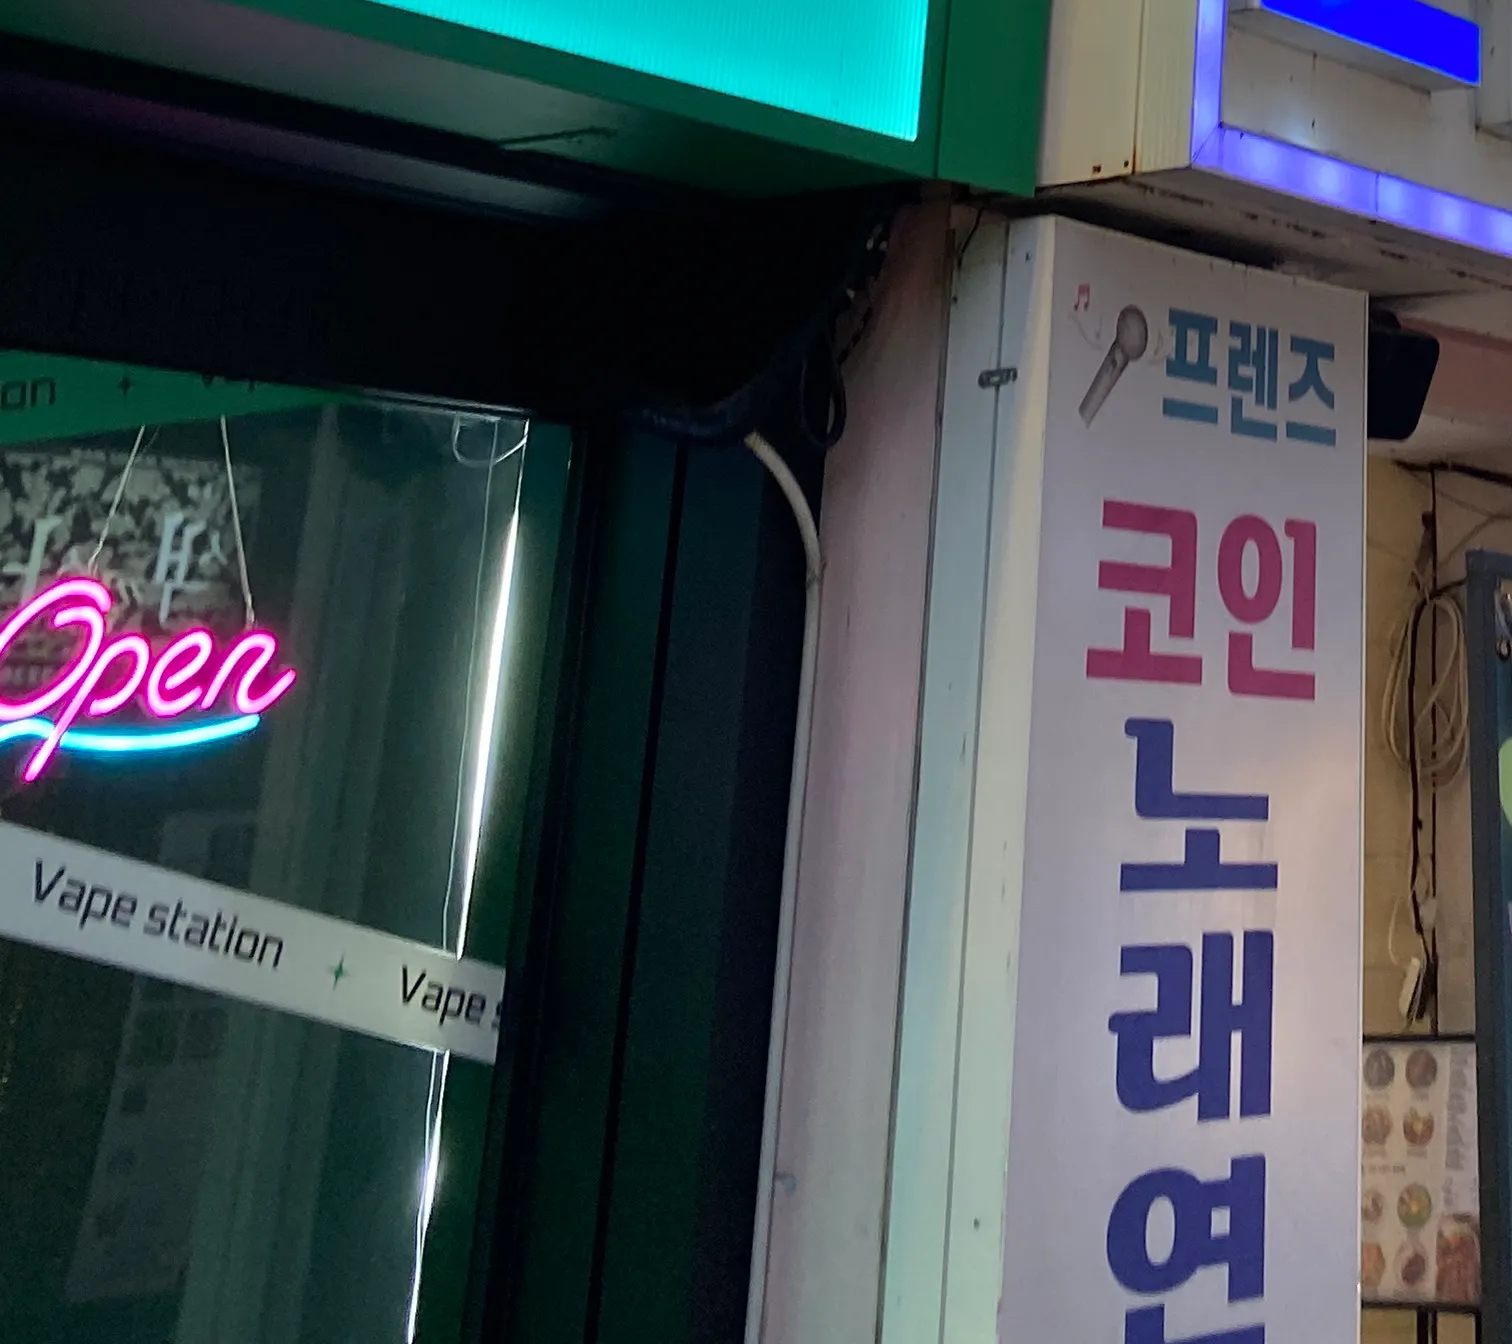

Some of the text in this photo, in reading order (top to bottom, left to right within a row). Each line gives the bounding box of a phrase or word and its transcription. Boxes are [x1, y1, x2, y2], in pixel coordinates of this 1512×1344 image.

[1162, 307, 1337, 447] 프렌즈
[0, 577, 297, 782] Open
[1086, 498, 1317, 702] 코인
[33, 859, 138, 931] Vape
[143, 894, 285, 970] station
[400, 964, 486, 1026] Vape
